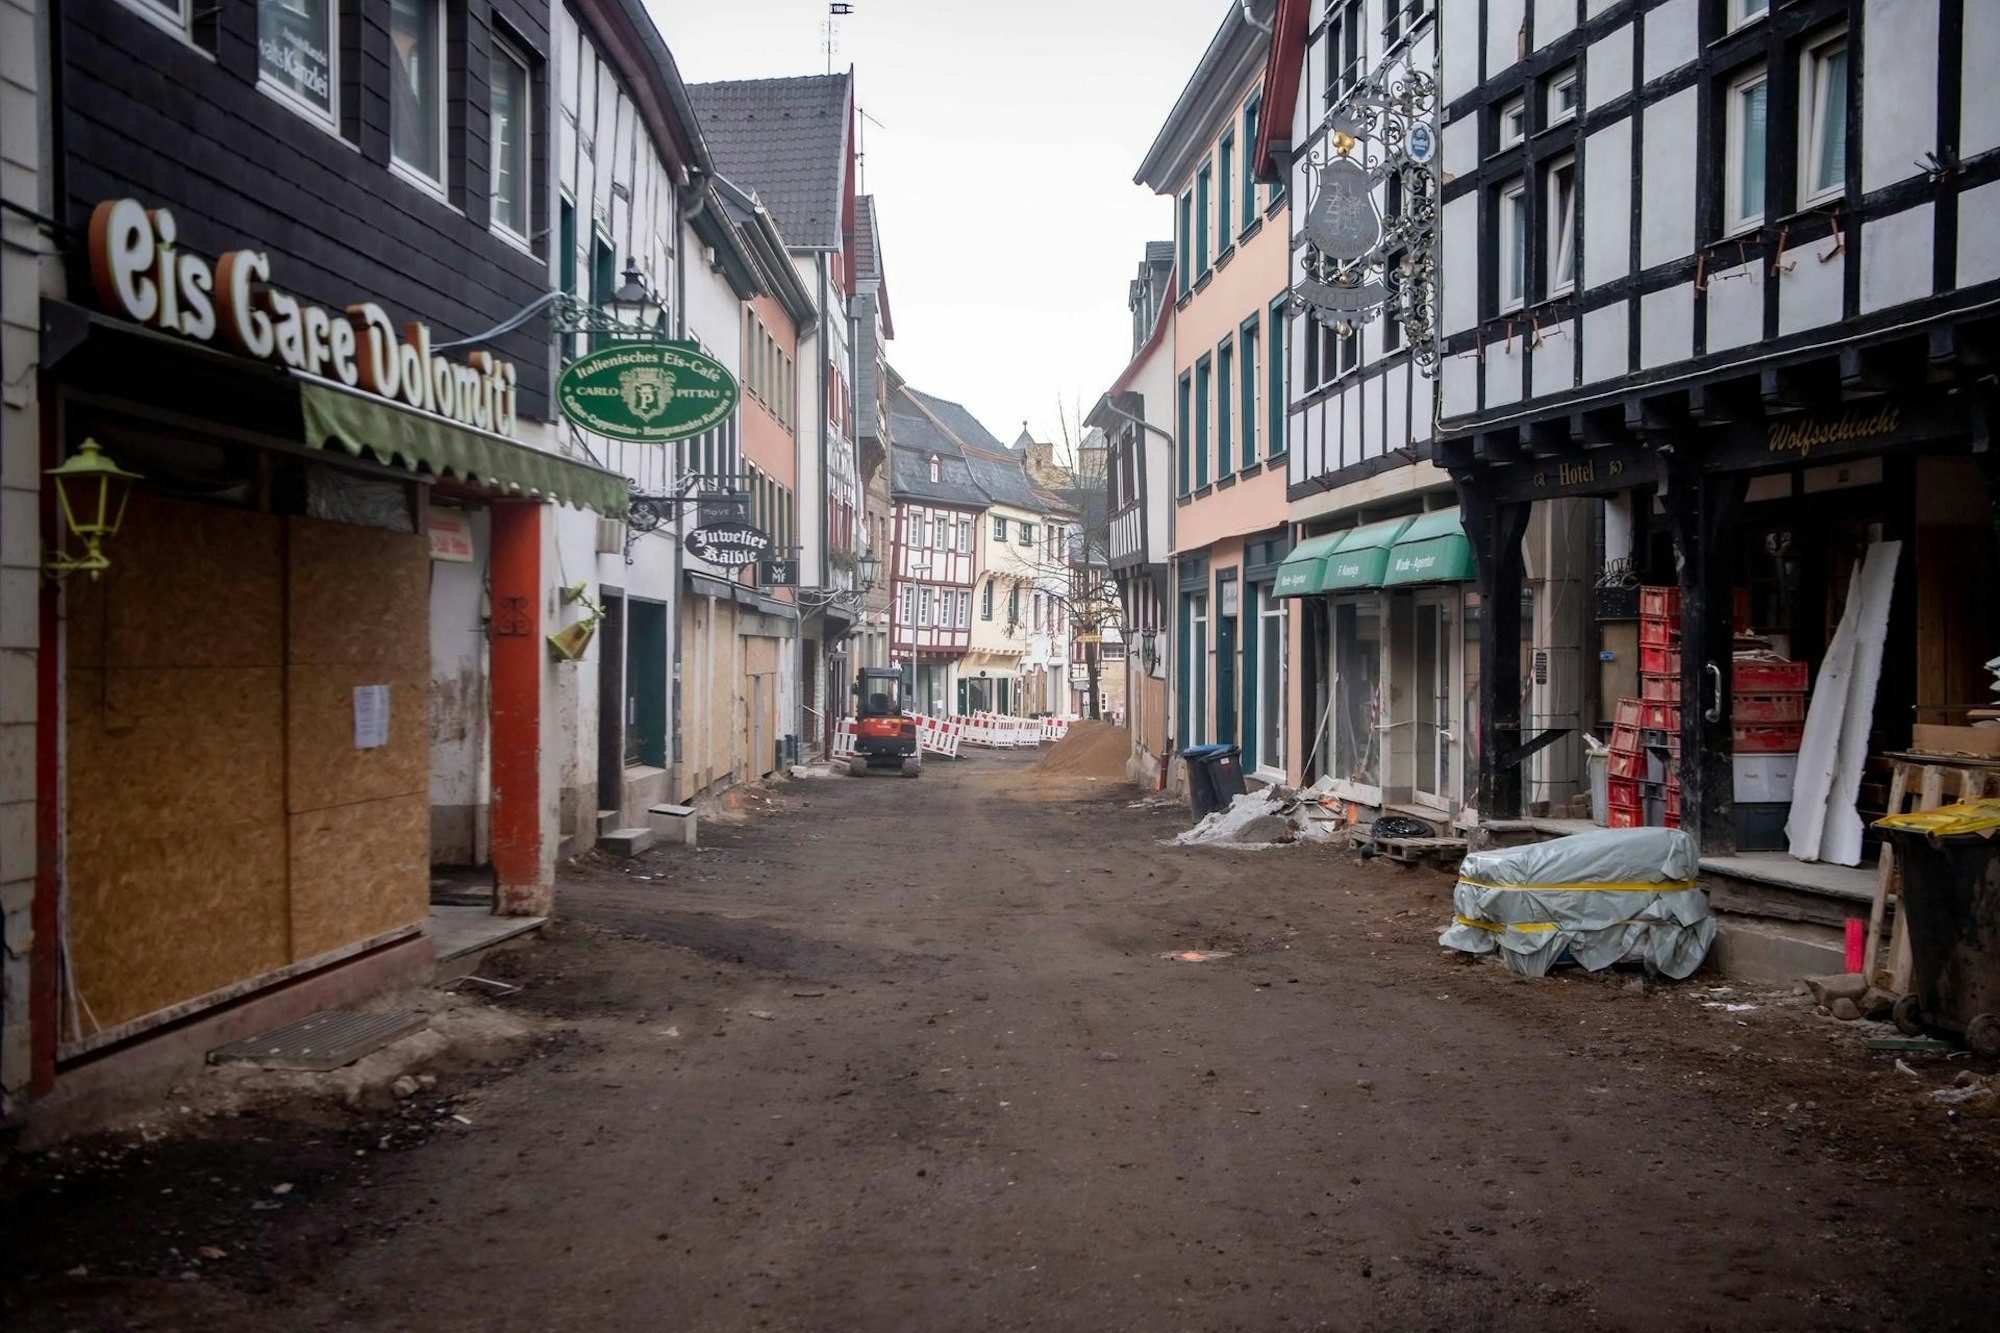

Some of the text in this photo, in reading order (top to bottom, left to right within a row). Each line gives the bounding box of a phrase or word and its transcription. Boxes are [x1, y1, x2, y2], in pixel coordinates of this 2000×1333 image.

[346, 302, 517, 437] Dolomiti
[575, 350, 721, 383] Italienisches Eis-Café
[576, 386, 720, 399] CARLO PITTAU
[1559, 459, 1595, 486] Hotel
[693, 529, 768, 549] Juwelier
[698, 545, 759, 564] Kälble
